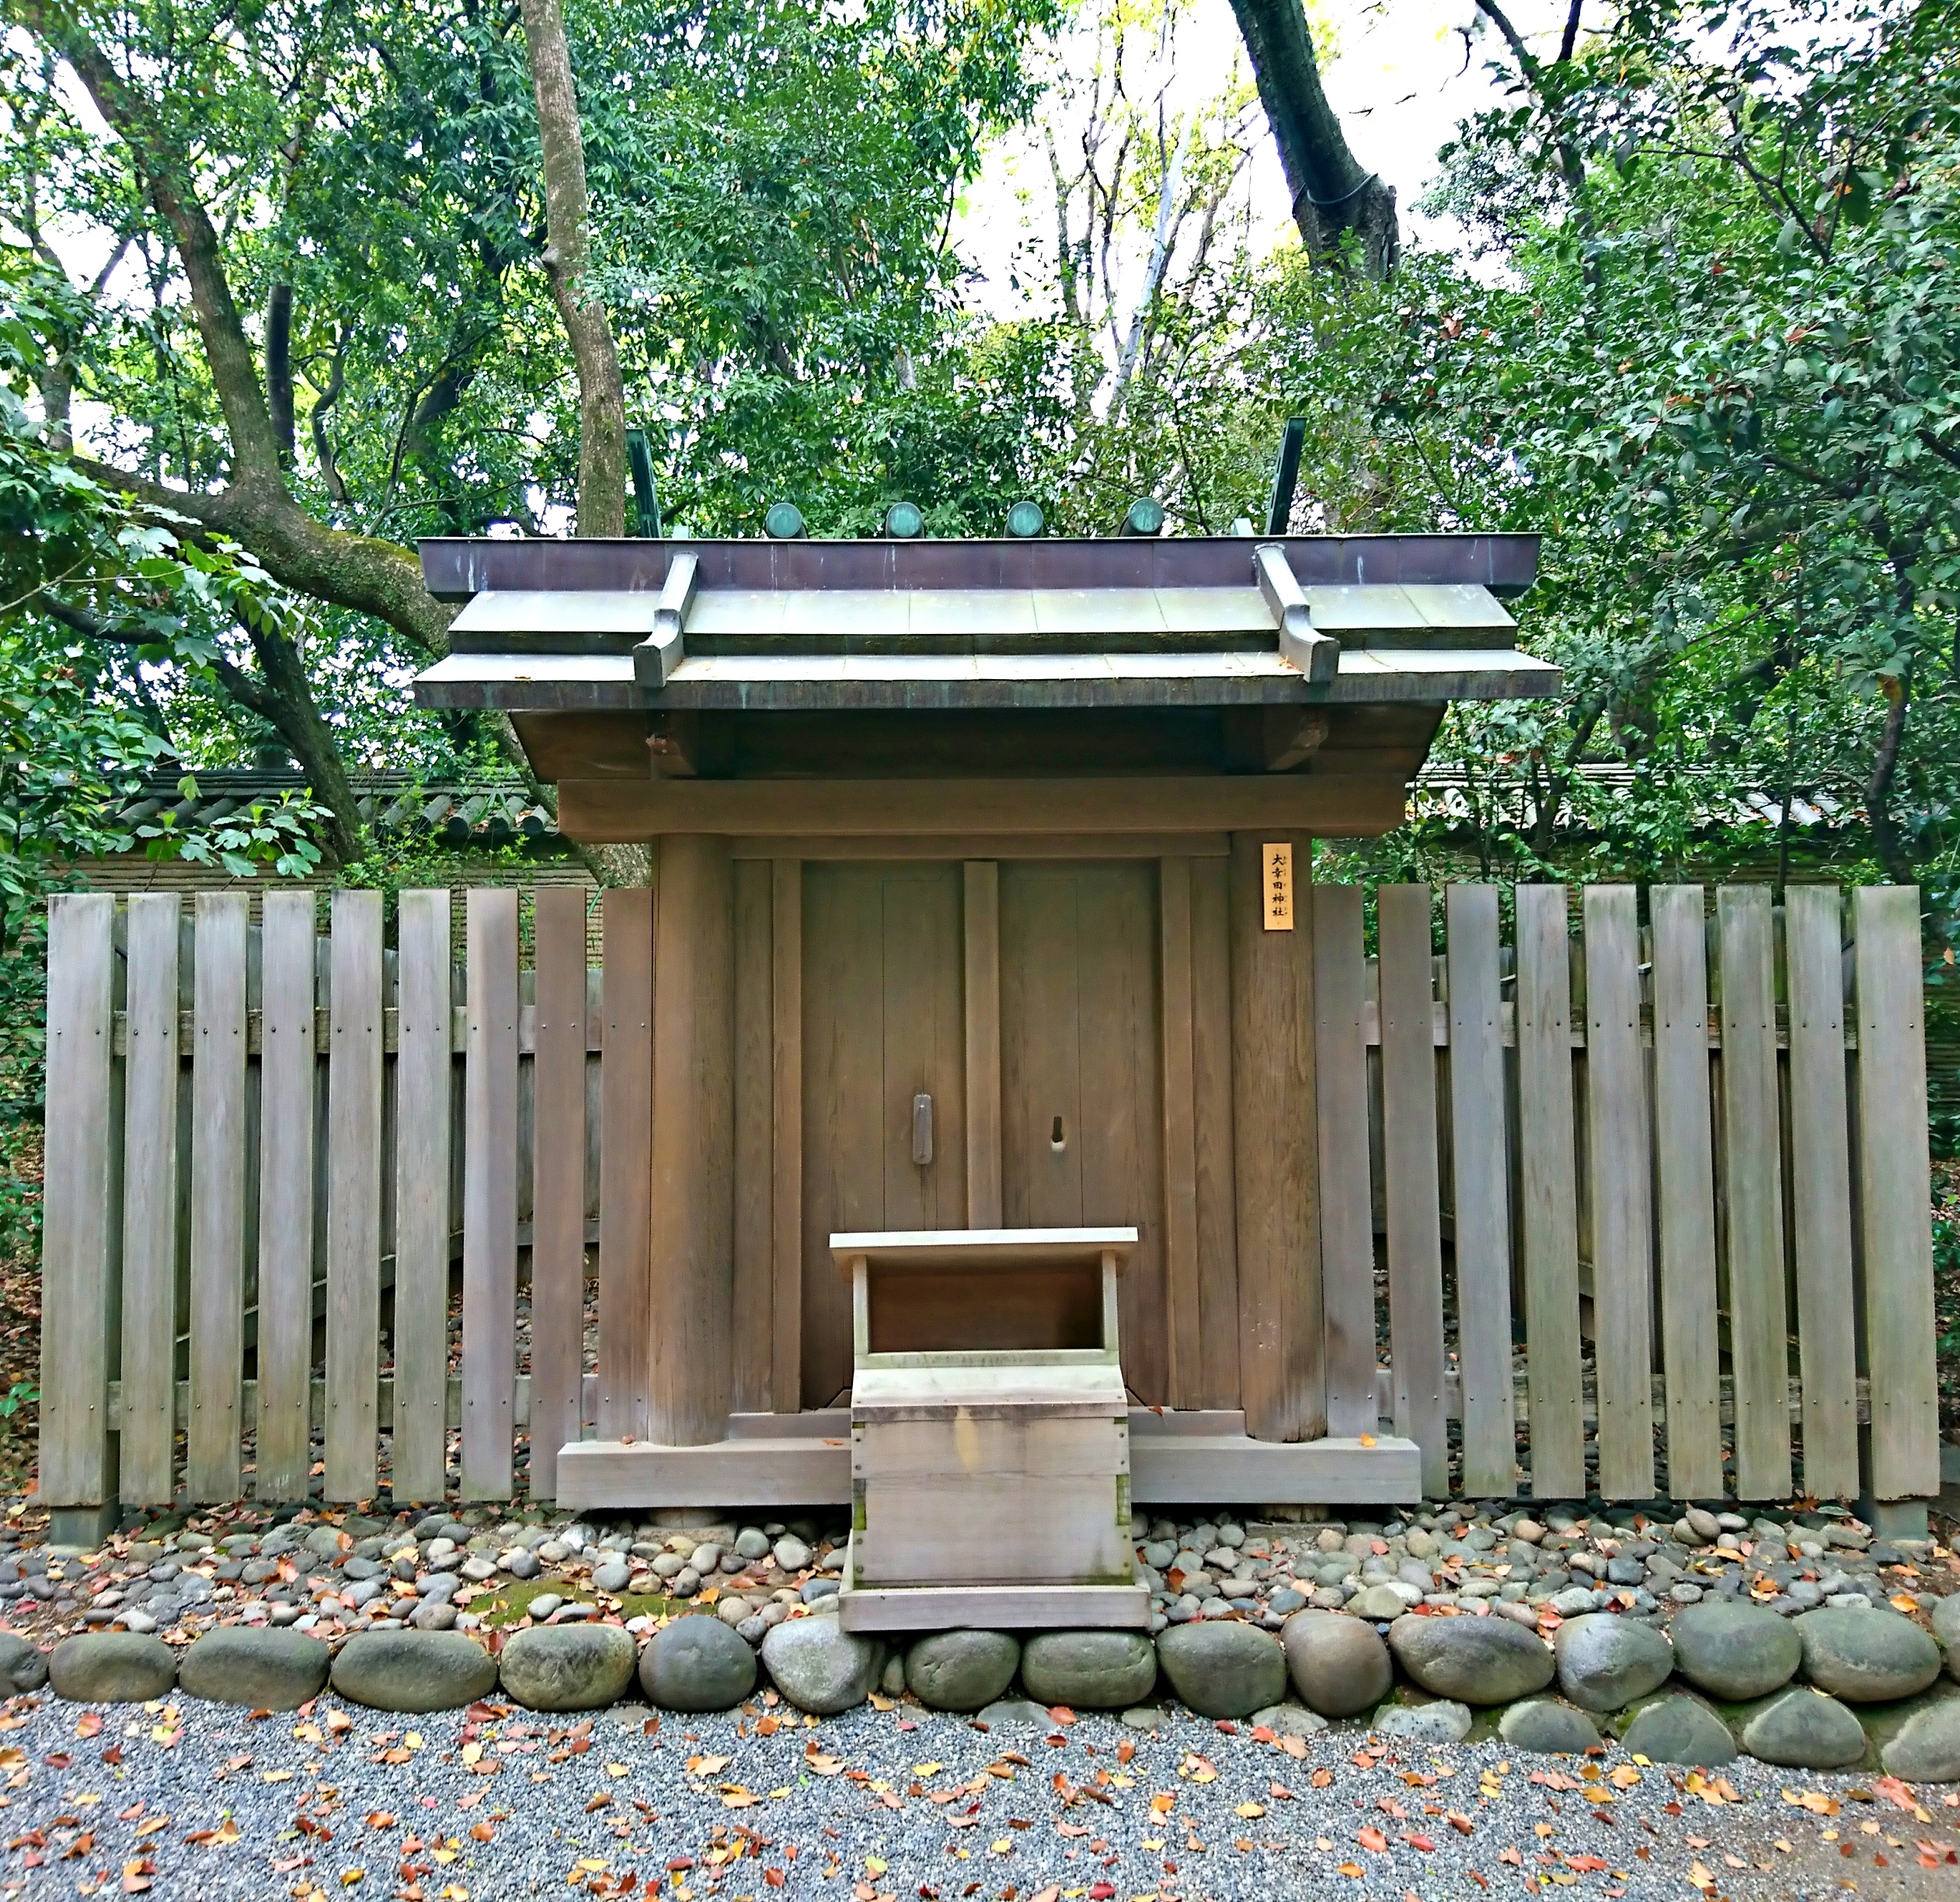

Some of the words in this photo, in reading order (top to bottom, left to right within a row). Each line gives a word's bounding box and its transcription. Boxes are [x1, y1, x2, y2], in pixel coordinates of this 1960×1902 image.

[1272, 854, 1284, 916] 大幸田神社
